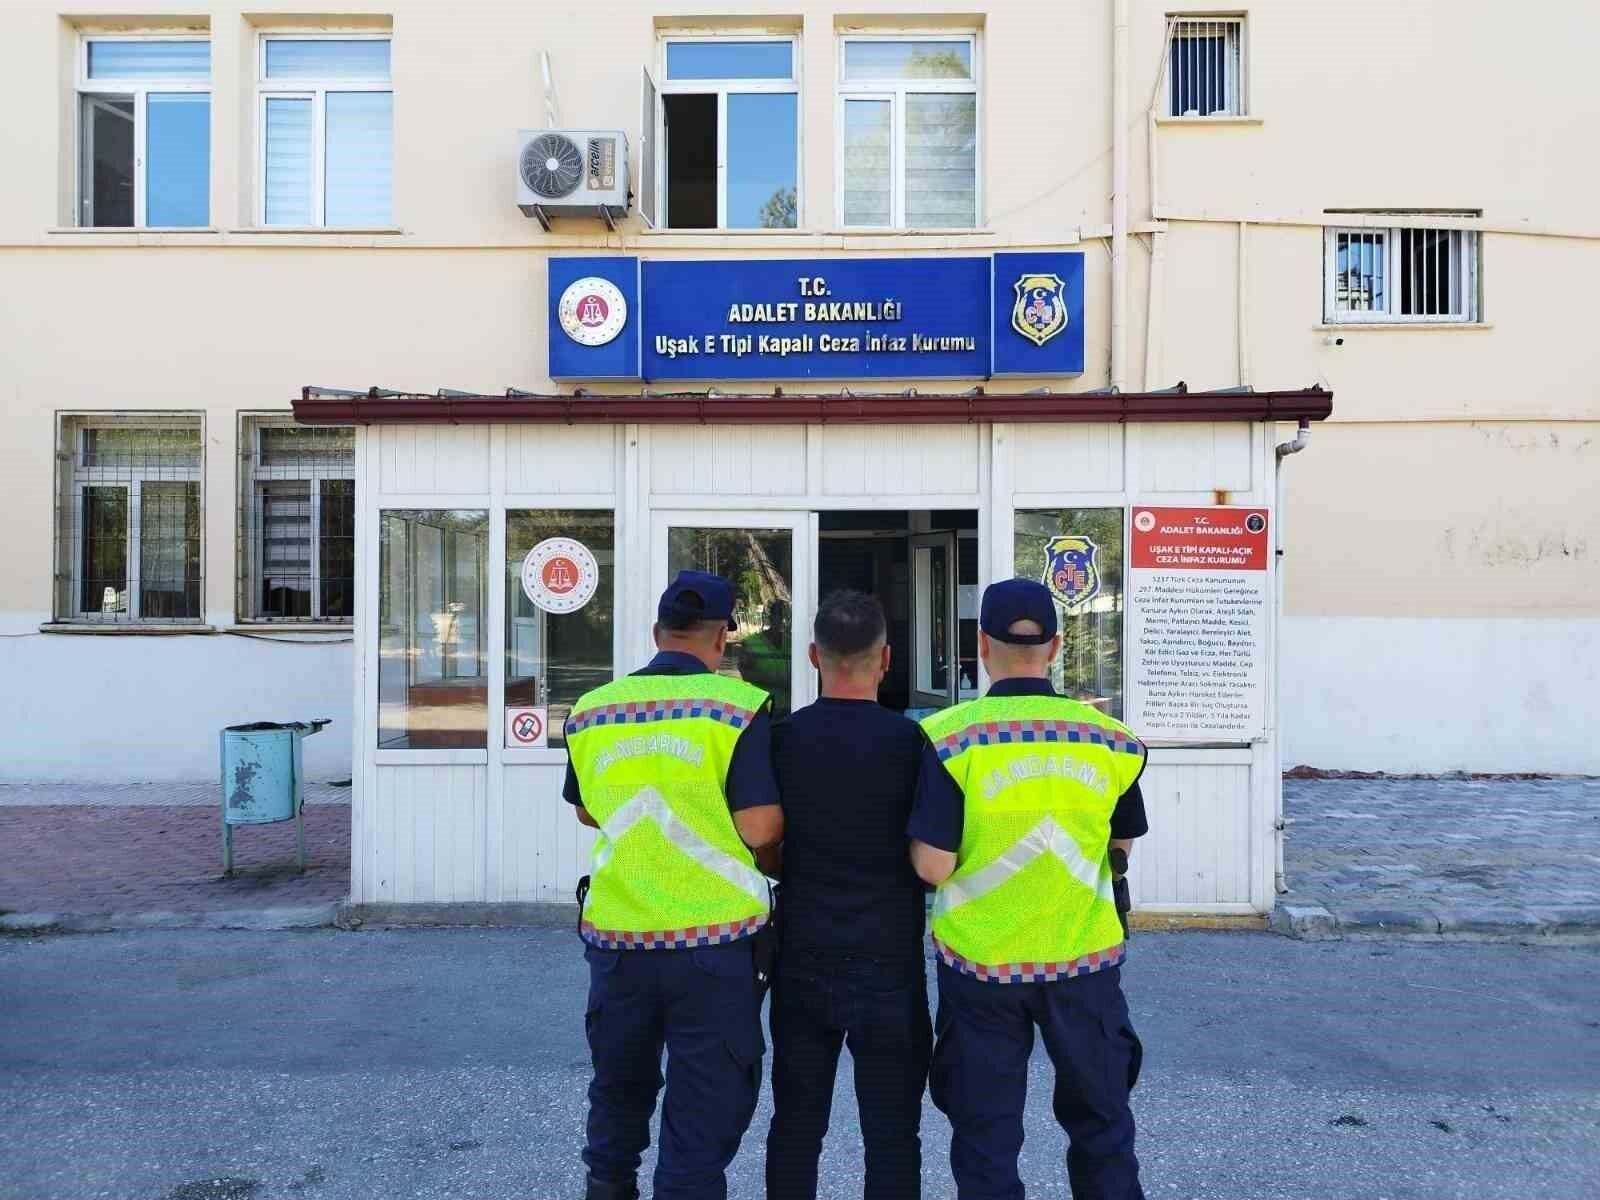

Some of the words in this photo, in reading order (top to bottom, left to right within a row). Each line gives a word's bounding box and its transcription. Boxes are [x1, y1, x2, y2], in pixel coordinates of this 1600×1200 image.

[798, 277, 831, 296] T.C.
[729, 303, 798, 322] ADALET
[805, 299, 902, 321] BAKANLIĞI
[655, 335, 699, 358] Uşak
[705, 335, 715, 350] E
[720, 334, 752, 356] Tipi
[759, 334, 813, 356] Kapalı
[819, 334, 860, 352] Ceza
[866, 330, 907, 351] İnfaz
[912, 333, 976, 352] Kurumu
[1161, 526, 1194, 534] ADALET
[1196, 526, 1243, 535] BAKANLIĞI
[1150, 546, 1174, 554] UŞAK
[1181, 545, 1198, 554] TİPİ
[1180, 554, 1206, 563] İNFAZ
[1207, 556, 1246, 564] KURUMU
[982, 755, 1110, 799] JANDARMA
